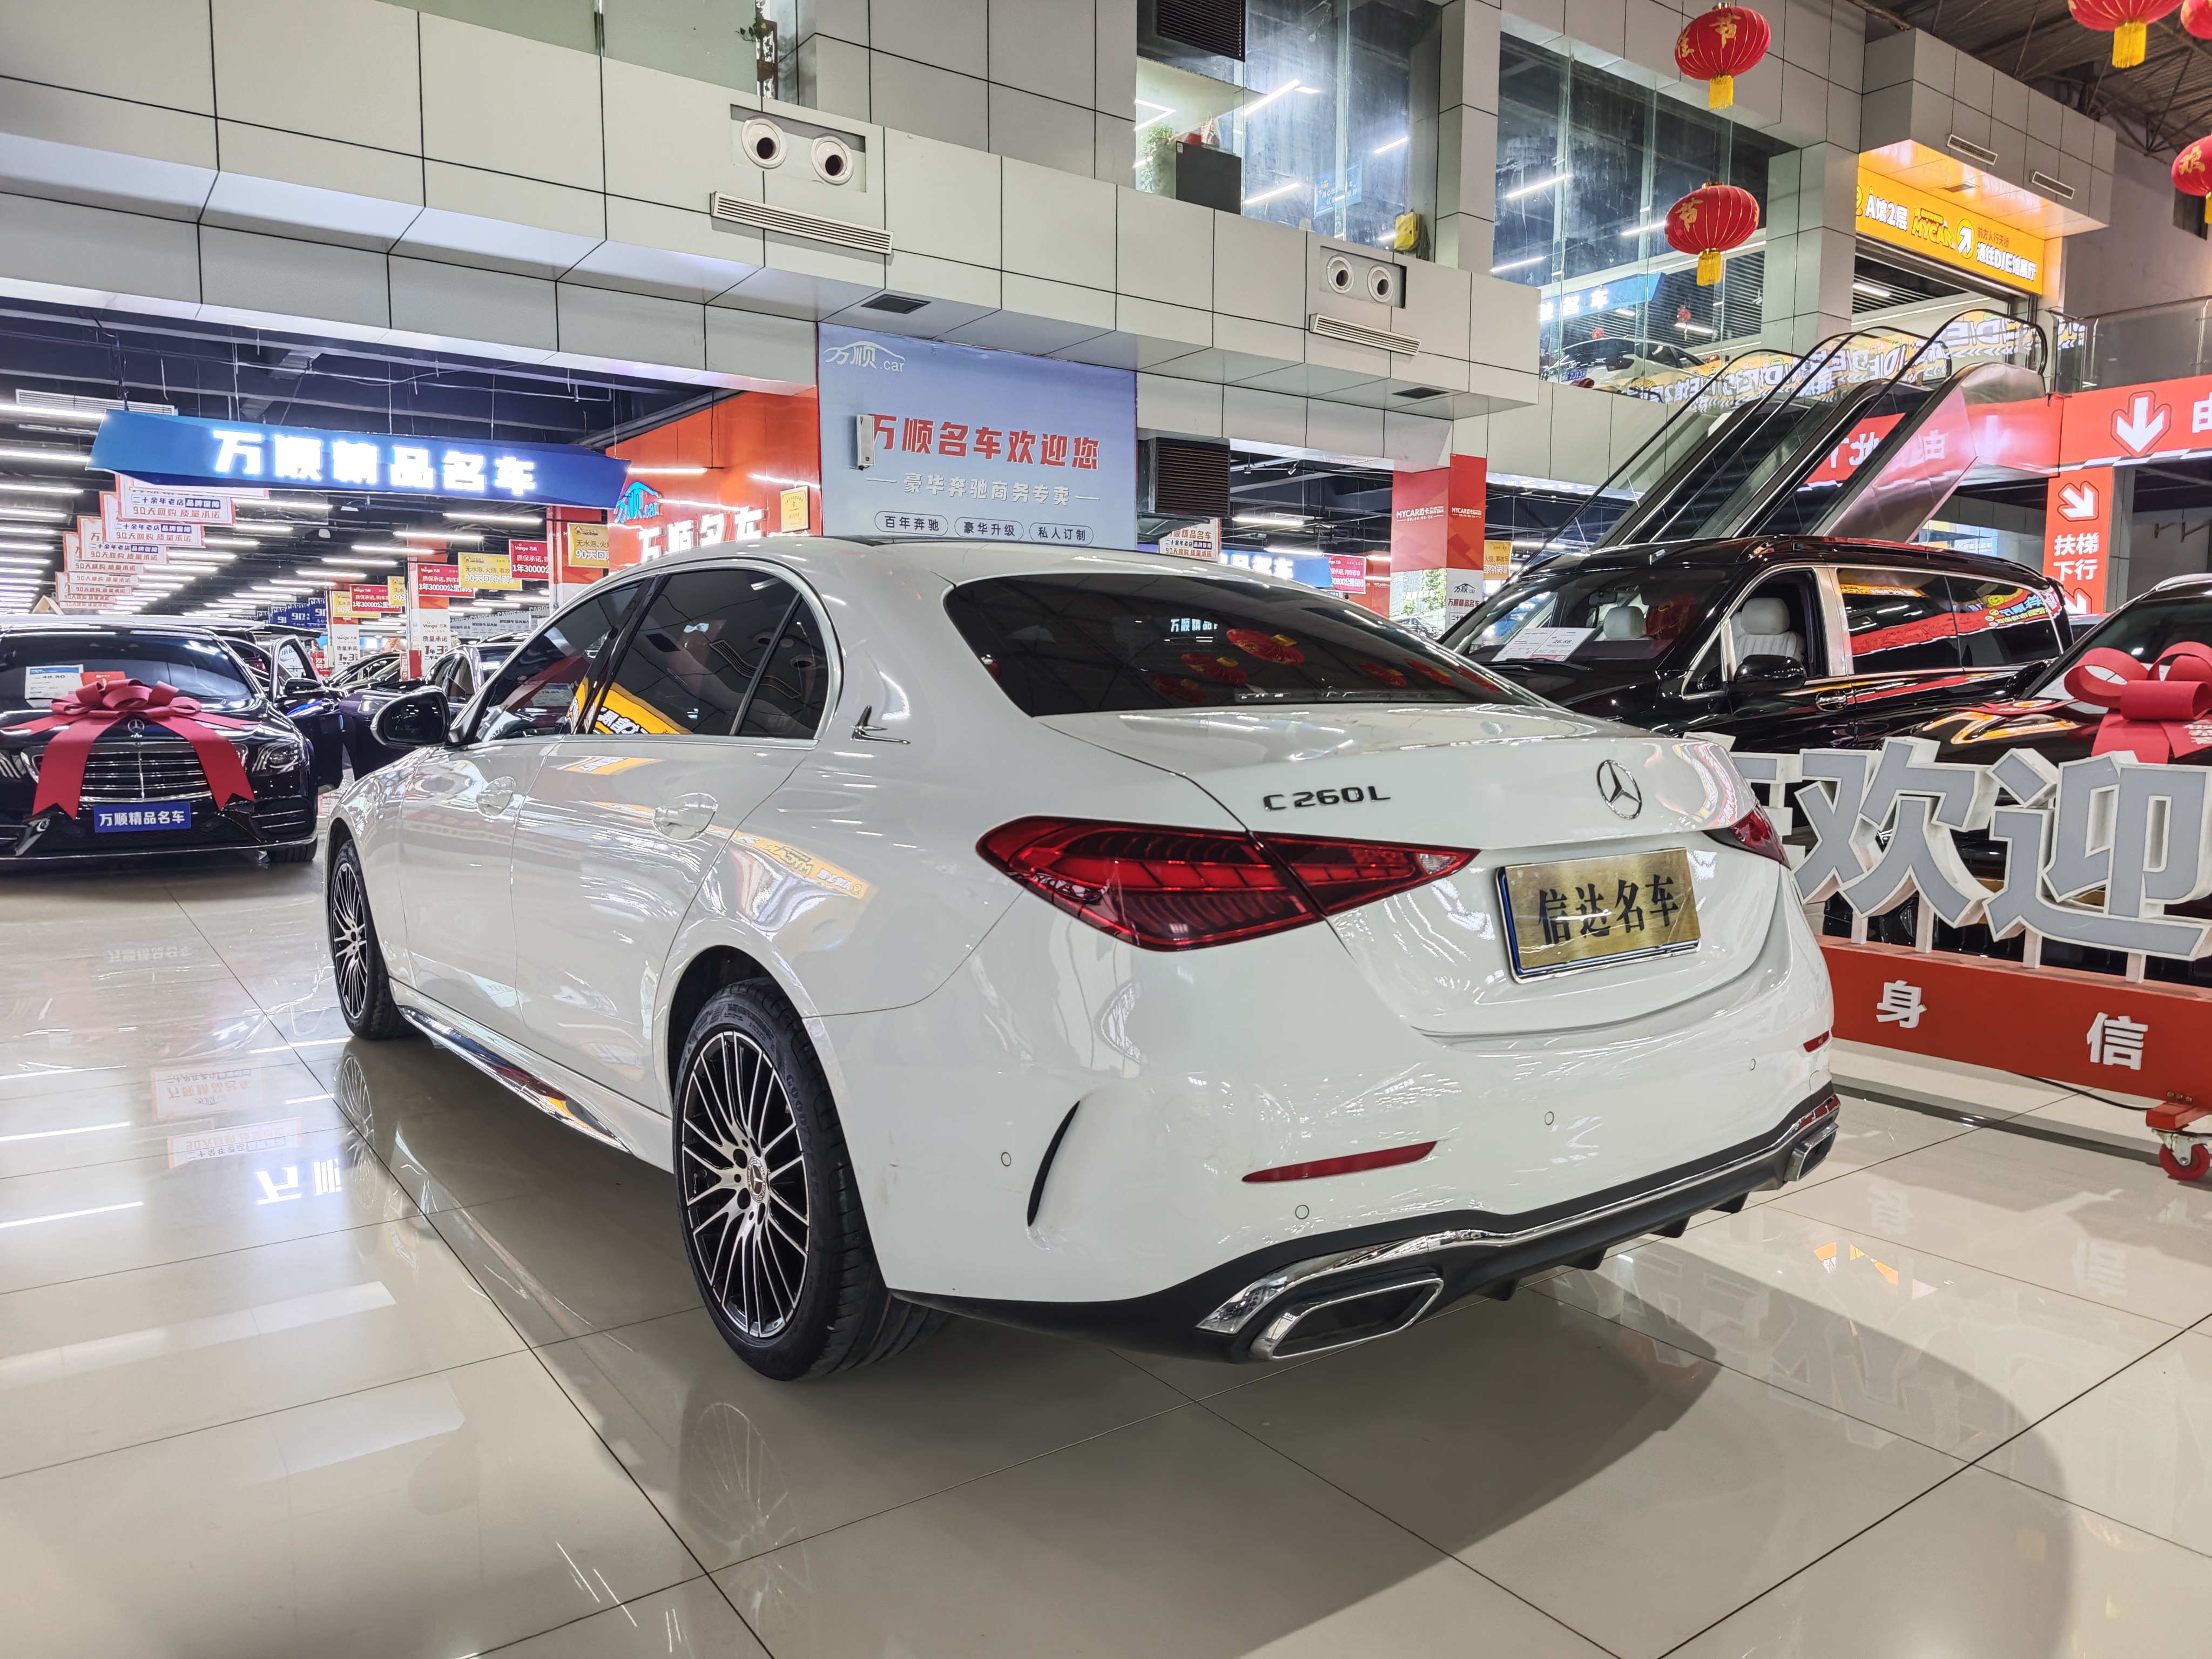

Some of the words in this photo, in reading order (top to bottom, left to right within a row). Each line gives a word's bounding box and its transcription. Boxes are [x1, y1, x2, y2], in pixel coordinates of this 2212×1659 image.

[1865, 194, 1908, 231] A馆2层
[1911, 215, 1954, 250] MYCAR
[1977, 227, 2009, 248] 前方人行天桥
[867, 414, 1100, 470] 万顺名车欢迎您
[213, 429, 536, 496] 万顺精品名车
[133, 496, 184, 506] 二十余年老店
[904, 472, 1070, 506] 豪华奔驰商务专卖
[133, 507, 177, 516] 90天回购
[181, 509, 220, 518] 质量承诺
[116, 532, 153, 540] 90天回购
[884, 515, 940, 532] 百年奔驰
[963, 521, 1016, 537] 豪华升级
[1038, 526, 1087, 541] 私人订制
[2054, 531, 2100, 557] 扶梯
[2053, 558, 2098, 581] 下行
[99, 811, 185, 827] 万顺精品名车
[1728, 736, 2212, 962] 欢迎
[1537, 875, 1678, 946] 信达名车
[1876, 981, 1927, 1028] 身
[2086, 1012, 2149, 1070] 信
